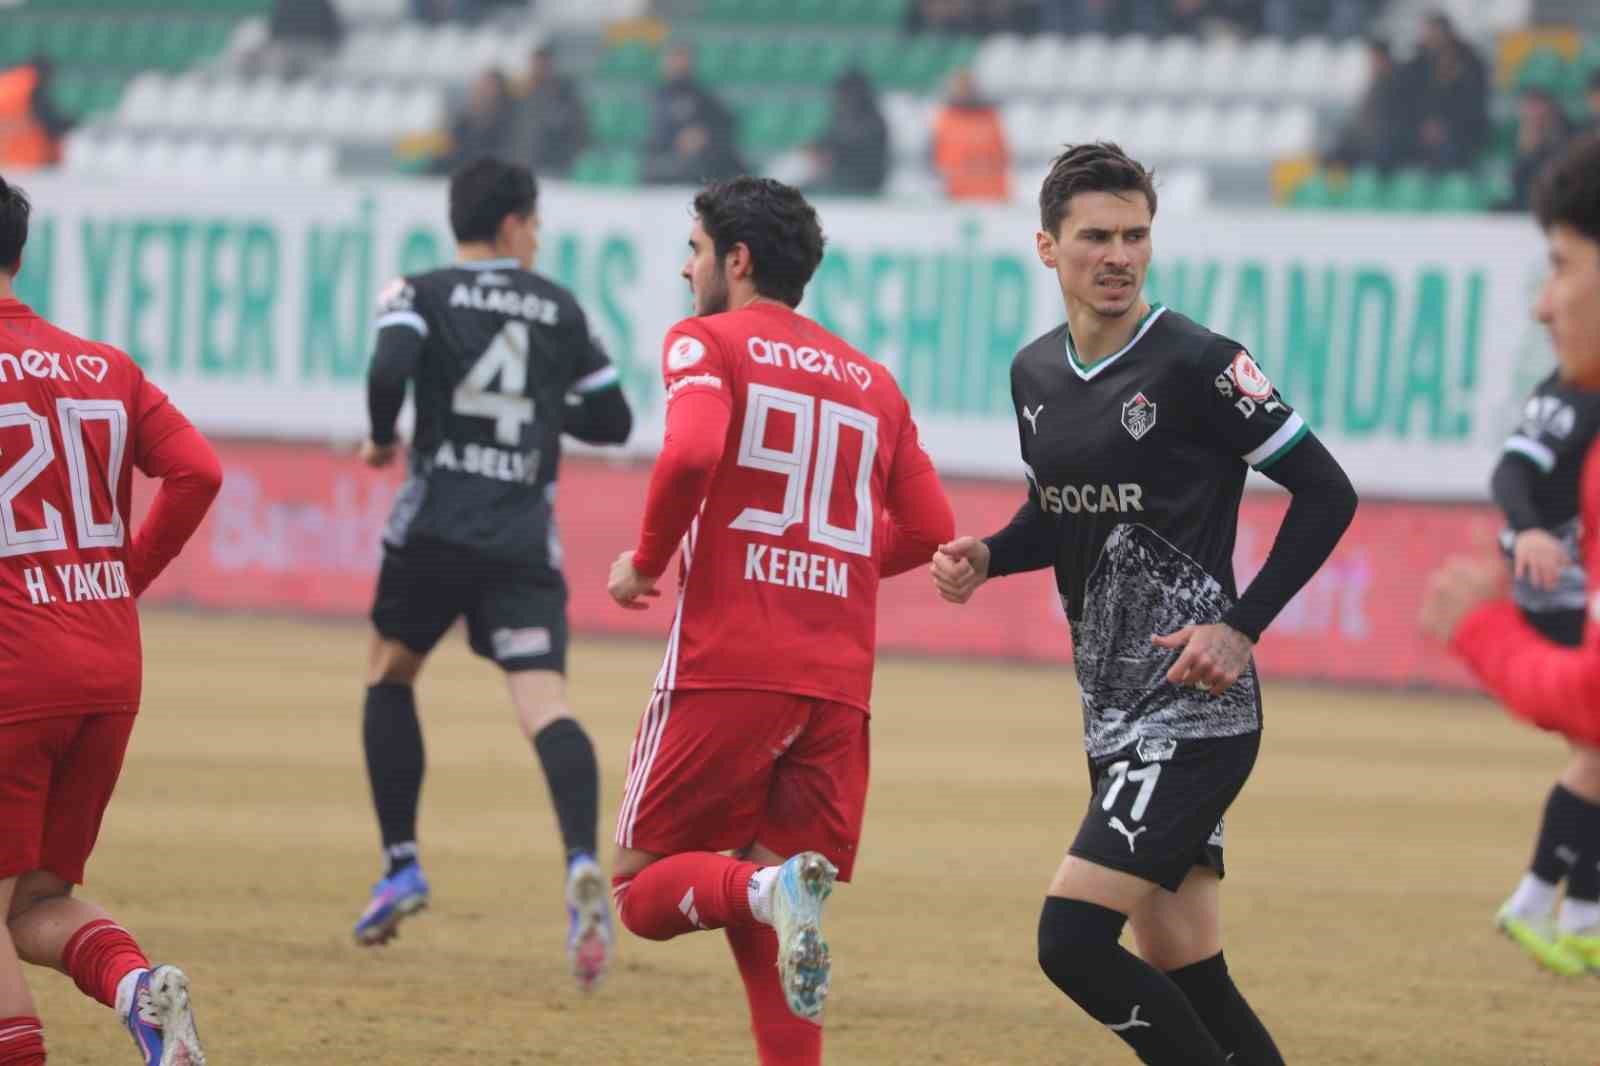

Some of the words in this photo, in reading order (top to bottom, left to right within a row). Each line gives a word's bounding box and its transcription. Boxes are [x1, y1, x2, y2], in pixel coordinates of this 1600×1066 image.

[79, 216, 281, 381] YETER
[0, 348, 71, 383] nex
[451, 319, 535, 447] 4
[746, 336, 842, 383] anex
[0, 397, 129, 558] 20
[728, 382, 879, 558] 90
[23, 566, 57, 605] H.
[744, 542, 849, 599] KEREM
